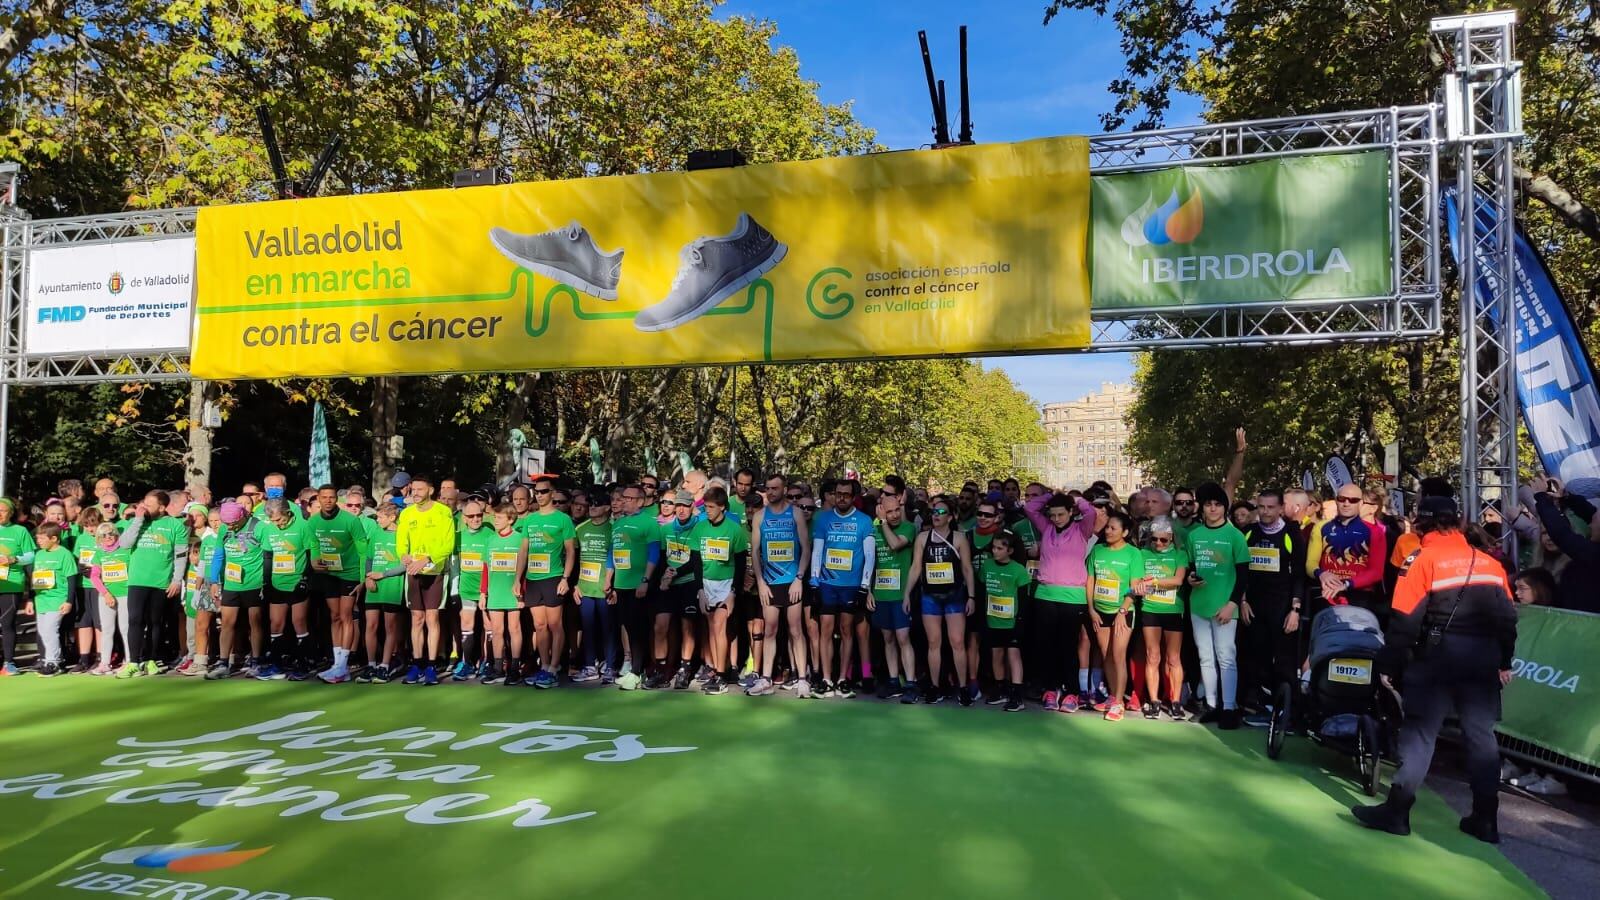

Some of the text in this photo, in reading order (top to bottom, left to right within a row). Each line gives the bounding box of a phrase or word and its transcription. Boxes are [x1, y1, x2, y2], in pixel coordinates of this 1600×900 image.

[244, 220, 403, 258] Valladolid
[866, 261, 1011, 281] asociación española
[1142, 247, 1351, 284] IBERDROLA
[39, 274, 190, 295] Ayuntamiento de Valladolid
[246, 260, 411, 295] en marcha
[865, 281, 979, 298] contra el cáncer
[37, 305, 86, 324] FMD
[89, 302, 188, 313] Fundación Municipal
[120, 311, 171, 320] Deportes
[865, 298, 955, 313] en Valladolid
[243, 311, 502, 347] contra el cáncer
[930, 547, 948, 556] LIFE
[1336, 665, 1358, 676] 19172
[116, 710, 698, 762] Juntos
[101, 747, 495, 784] contra
[0, 769, 596, 827] el cáncer
